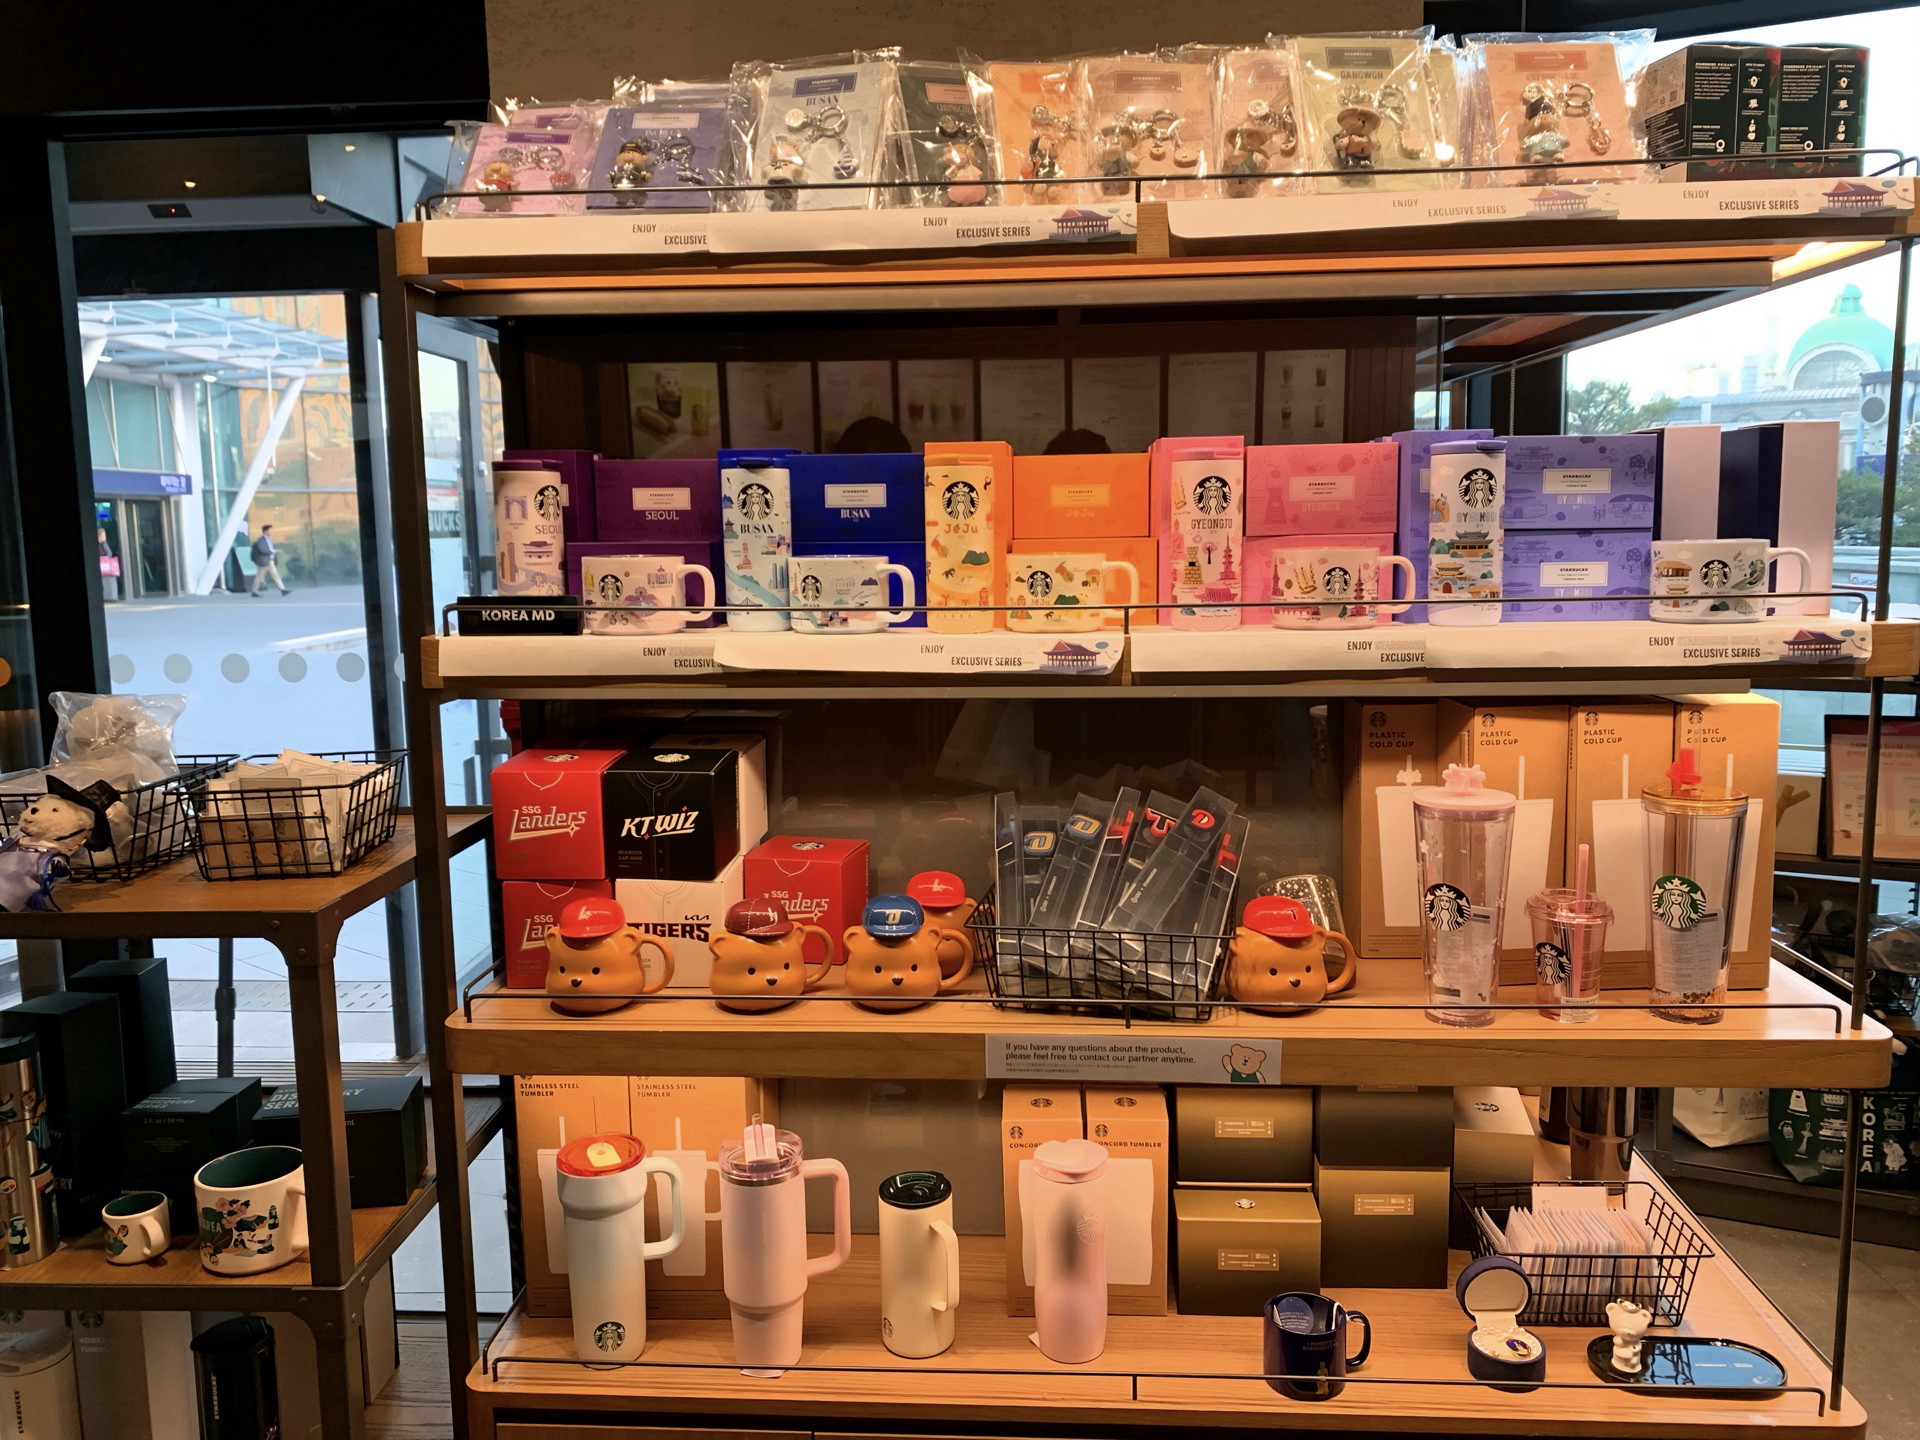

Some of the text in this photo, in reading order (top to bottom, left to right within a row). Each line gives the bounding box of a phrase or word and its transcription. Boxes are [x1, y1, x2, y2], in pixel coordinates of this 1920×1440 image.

[1341, 70, 1384, 80] GANGWON
[806, 95, 839, 106] BUSAN
[1683, 190, 1710, 199] ENJOY
[1392, 199, 1418, 208] ENJOY
[1719, 200, 1799, 211] EXCLUSIVE SERIES
[1428, 205, 1506, 217] EXCLUSIVE SERIES
[923, 217, 948, 227] ENJOY
[632, 224, 657, 233] ENJOY
[956, 226, 1031, 238] EXCLUSIVE SERIES
[664, 235, 707, 245] EXCLUSIVE
[645, 511, 680, 521] SEOUL
[840, 509, 871, 519] BUSAN
[740, 523, 774, 534] BUSAN
[1191, 518, 1233, 530] GYEONGJU
[481, 609, 555, 622] KOREA MD
[1347, 641, 1372, 651] ENJOY
[1649, 636, 1675, 646] ENJOY
[643, 647, 667, 656] ENJOY
[921, 645, 945, 654] ENJOY
[1683, 648, 1761, 658] EXCLUSIVE SERIES
[951, 656, 1022, 666] EXCLUSIVE SERIES
[1381, 652, 1425, 662] EXCLUSIVE
[674, 658, 715, 668] EXCLUSIVE
[1369, 731, 1406, 739] PLASTIC
[1369, 740, 1415, 748] COLD CUP
[521, 806, 542, 814] SSG
[509, 806, 588, 841] Landers
[620, 816, 655, 838] KT
[771, 890, 789, 899] SSG
[533, 914, 554, 923] SSG
[626, 923, 712, 943] TIGERS
[1005, 1043, 1012, 1051] If
[1030, 1043, 1050, 1051] have
[1051, 1045, 1066, 1053] any
[1068, 1044, 1107, 1053] questions
[1109, 1044, 1133, 1053] about
[1135, 1045, 1149, 1053] the
[1150, 1046, 1186, 1055] product,
[1005, 1052, 1032, 1061] please
[1033, 1052, 1049, 1060] feel
[1050, 1052, 1067, 1060] free
[1069, 1053, 1078, 1061] to
[1080, 1053, 1110, 1061] contact
[1128, 1054, 1159, 1063] partner
[1160, 1054, 1197, 1064] anytime.
[1860, 1096, 1876, 1173] KOREA
[211, 1376, 220, 1420] STARBUCKS
[14, 1390, 24, 1434] STARBUCKS
